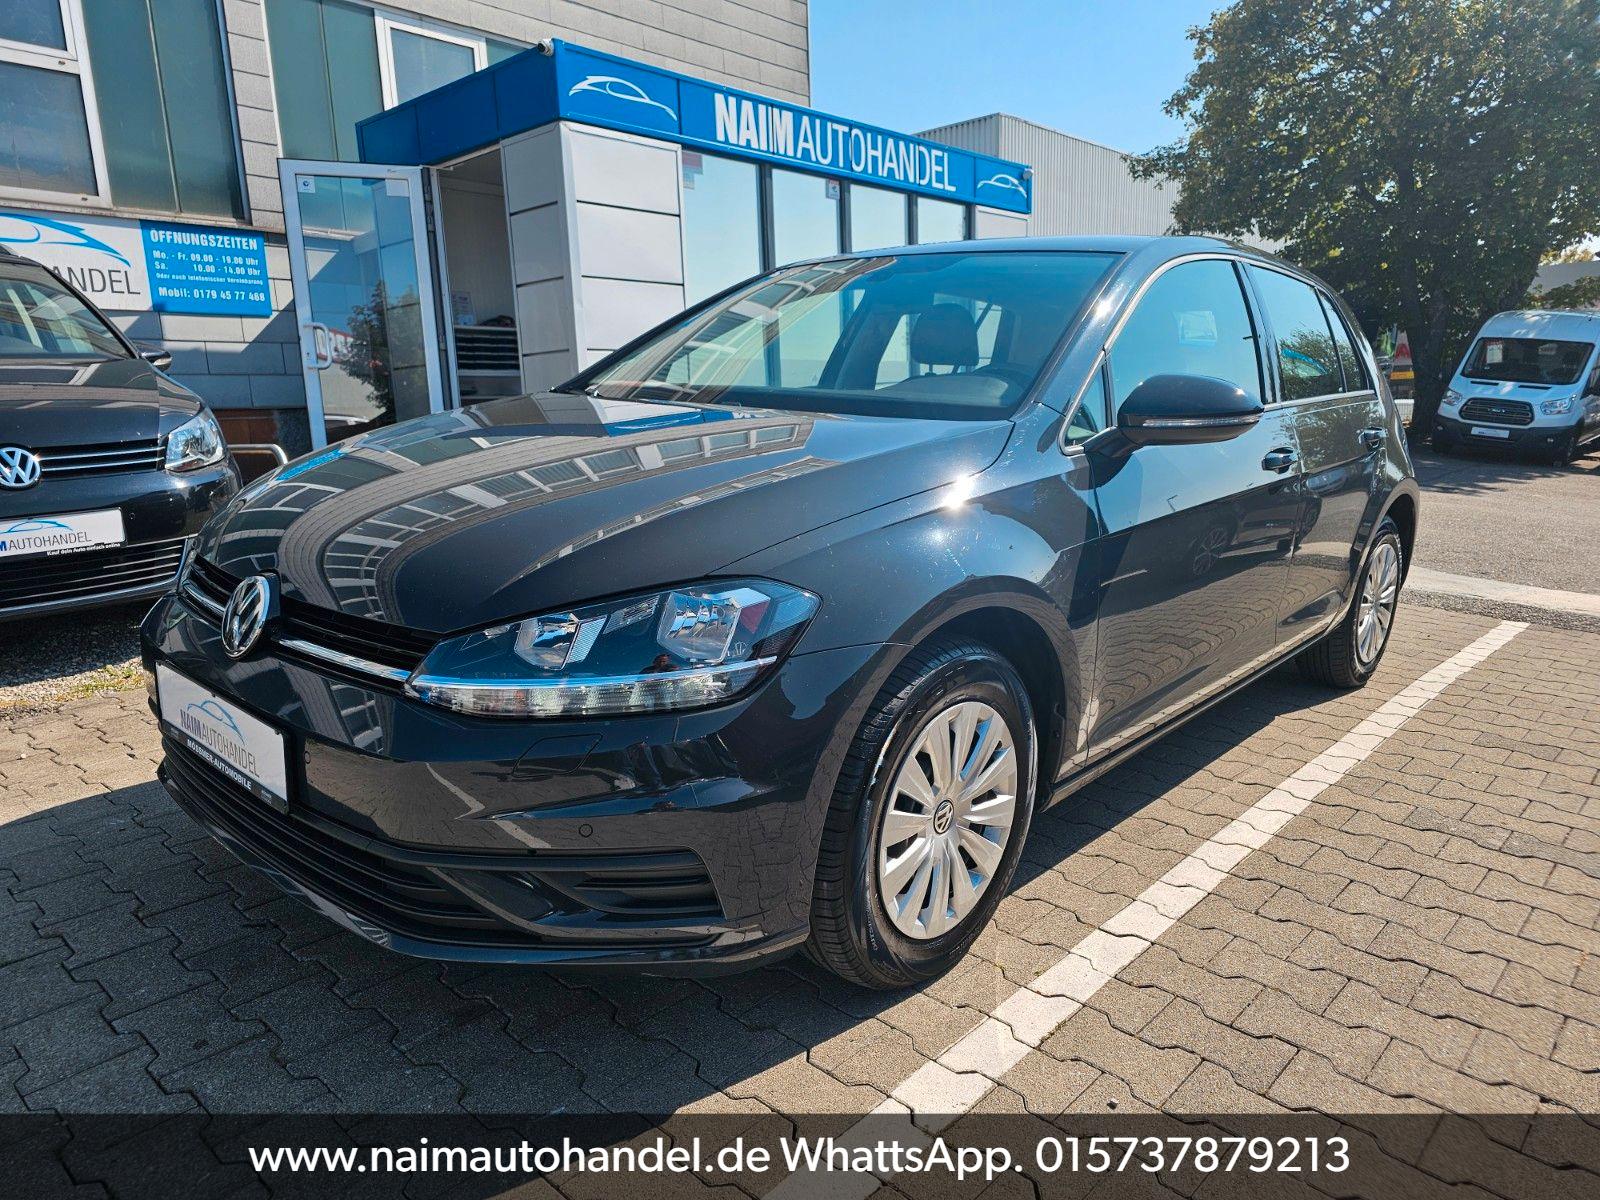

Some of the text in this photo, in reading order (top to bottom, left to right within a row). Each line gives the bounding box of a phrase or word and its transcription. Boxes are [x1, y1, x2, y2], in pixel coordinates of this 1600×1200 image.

[152, 250, 169, 260] Mo.
[177, 252, 188, 260] Fr.
[246, 258, 259, 266] Uhr
[154, 261, 169, 270] Sa.
[193, 263, 216, 273] 10.00
[247, 267, 260, 276] Uhr
[158, 286, 191, 298] Mobil:
[193, 288, 218, 299] 0179
[234, 291, 246, 300] 77
